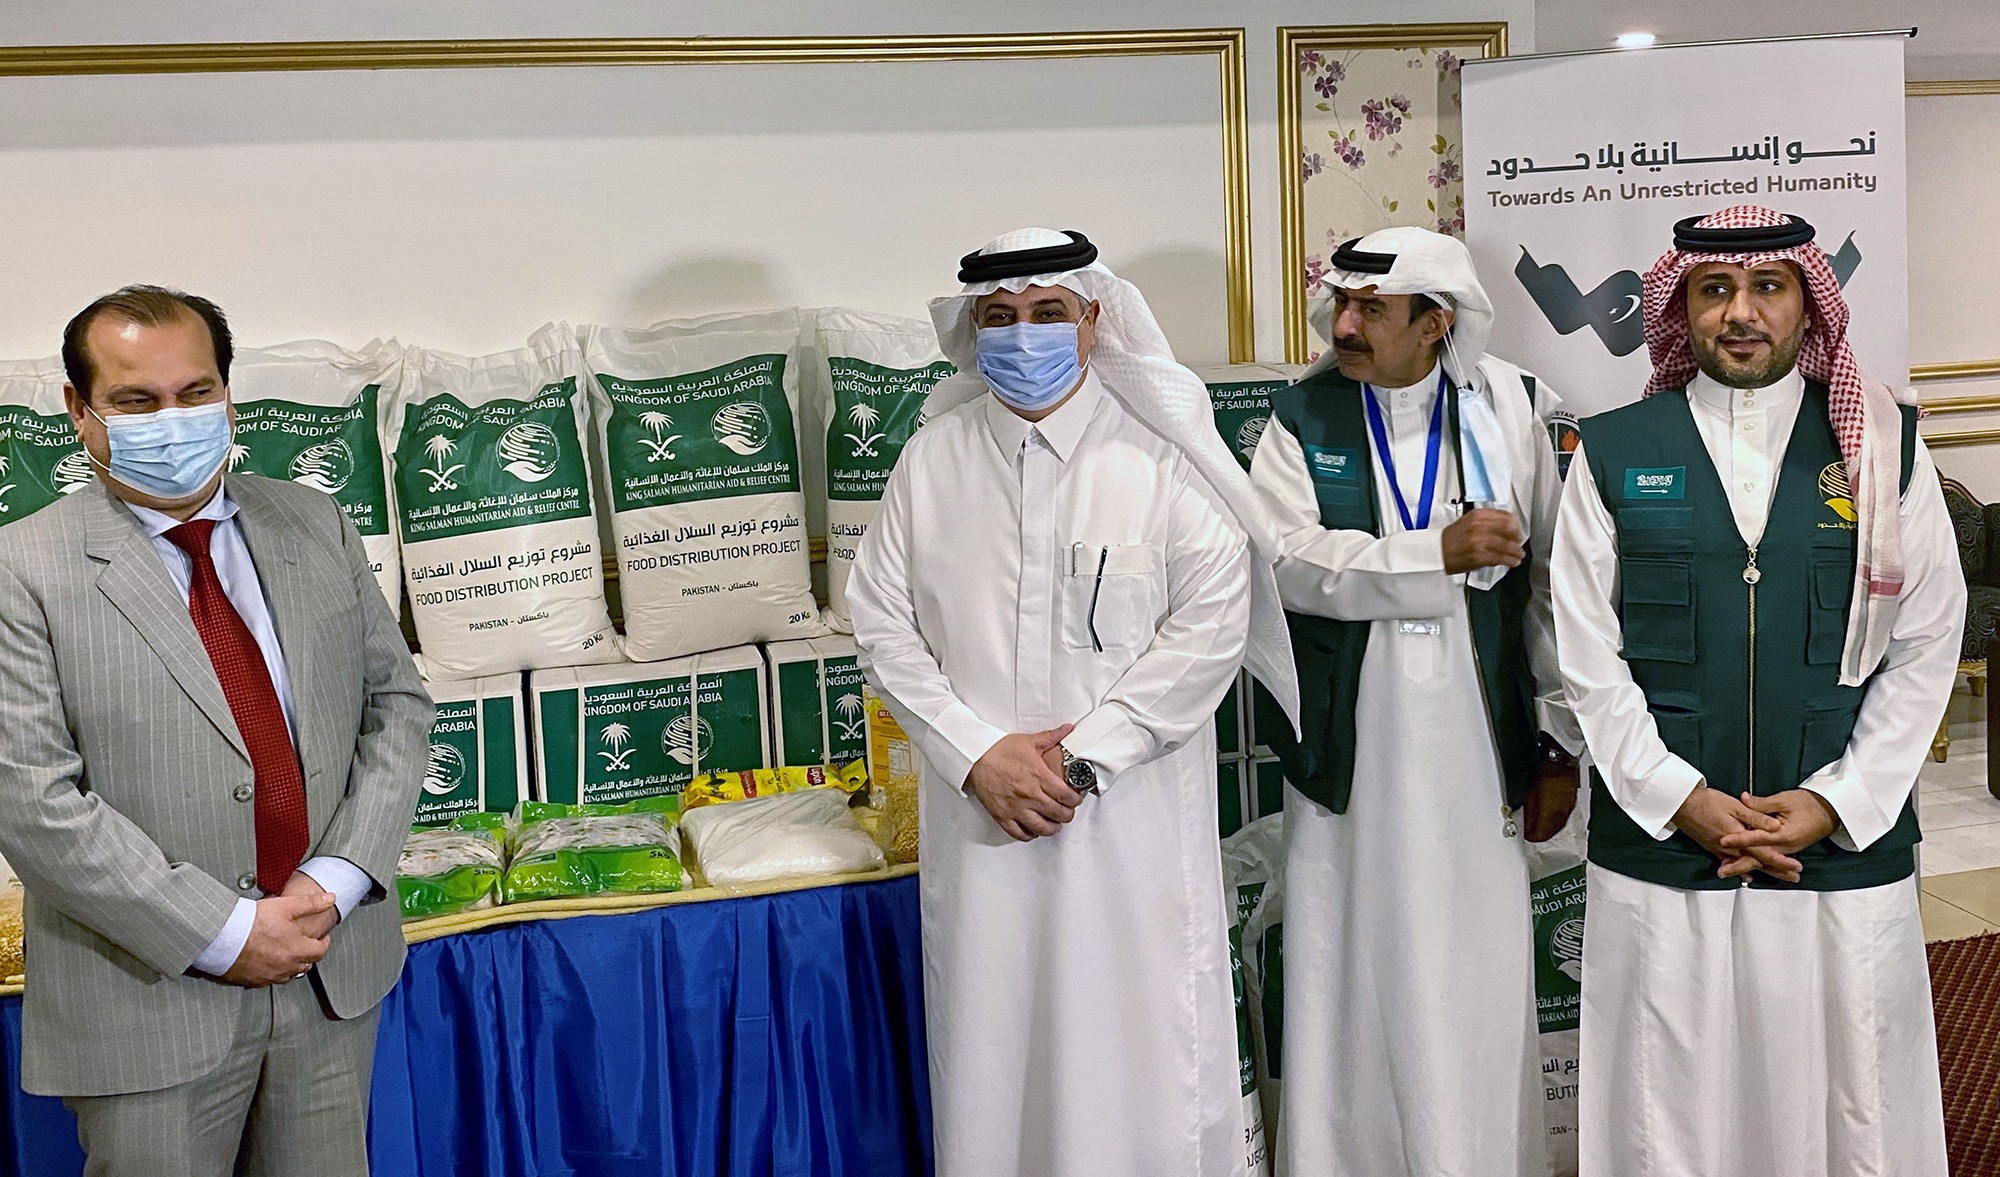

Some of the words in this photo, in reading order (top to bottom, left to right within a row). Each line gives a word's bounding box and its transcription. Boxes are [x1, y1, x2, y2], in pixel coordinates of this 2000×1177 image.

[1596, 143, 1625, 175] بلا
[1630, 136, 1780, 173] إنسانية
[1486, 152, 1591, 180] حدود
[1487, 186, 1575, 208] Towards
[1582, 185, 1612, 202] An
[1619, 176, 1759, 201] Unrestricted
[1767, 172, 1877, 193] Humanity
[723, 361, 773, 384] المملكة
[831, 366, 885, 382] السعودية
[889, 369, 930, 383] العربية
[611, 382, 672, 396] السعودية
[612, 394, 671, 405] KINGDOM
[674, 394, 690, 404] OF
[692, 387, 731, 401] SAUDI
[732, 375, 773, 394] ARABIA
[676, 375, 720, 392] العربية
[884, 385, 900, 394] OF
[1216, 387, 1249, 399] العربية
[1213, 401, 1226, 410] OF
[1226, 399, 1255, 410] SAUDI
[267, 406, 316, 423] العربية
[22, 415, 69, 434] العربية
[260, 420, 280, 432] OF
[281, 422, 323, 437] SAUDI
[14, 430, 33, 442] OF
[34, 434, 79, 447] SAUDI
[625, 490, 643, 501] KING
[643, 486, 670, 499] SALMAN
[671, 479, 726, 495] HUMANITARIAN
[726, 478, 739, 488] AID
[740, 478, 746, 486] &
[746, 475, 768, 486] RELIEF
[767, 474, 791, 485] CENTRE
[351, 516, 373, 526] ENTRE
[410, 521, 426, 533] KING
[426, 517, 453, 530] SALMAN
[453, 508, 512, 527] HUMANITARIAN
[512, 506, 526, 518] AID
[527, 505, 534, 515] &
[534, 502, 556, 514] RELIEF
[556, 499, 580, 511] CENTRE
[760, 513, 799, 534] مشروع
[674, 523, 715, 543] السلال
[720, 519, 757, 539] توزيع
[623, 529, 670, 550] الغذائية
[507, 547, 546, 571] توزيع
[550, 540, 592, 564] مشروع
[627, 557, 657, 572] FOOD
[660, 545, 750, 567] DISTRIBUTION
[753, 539, 801, 556] PROJECT
[411, 562, 454, 584] الغذائية
[459, 555, 502, 576] السلال
[416, 591, 443, 606] FOOD
[445, 576, 540, 603] DISTRIBUTION
[542, 567, 593, 587] PROJECT
[681, 584, 720, 597] PAKISTAN
[728, 580, 759, 592] باكستان
[469, 618, 509, 631] PAKISTAN
[517, 611, 549, 625] باكستان
[789, 613, 801, 624] 20
[582, 638, 594, 650] 20
[677, 678, 722, 692] الممكة
[816, 674, 864, 688] KNGDOM
[584, 688, 633, 704] السعودي
[637, 684, 674, 699] العربية
[633, 701, 648, 711] OF
[649, 697, 681, 709] SAUDI
[683, 692, 723, 706] AABIA
[436, 706, 476, 719] المملك
[433, 721, 476, 734] ARABIA
[584, 794, 600, 803] KING
[600, 791, 624, 801] SALMAN
[625, 785, 670, 799] HUMANITARIAN
[464, 798, 478, 808] ركز
[420, 814, 431, 823] AID
[432, 813, 437, 821] &
[438, 811, 457, 820] RELIEF
[1563, 993, 1579, 1007] لمان
[1538, 1011, 1566, 1024] ITARIAN
[1567, 1008, 1579, 1019] AID
